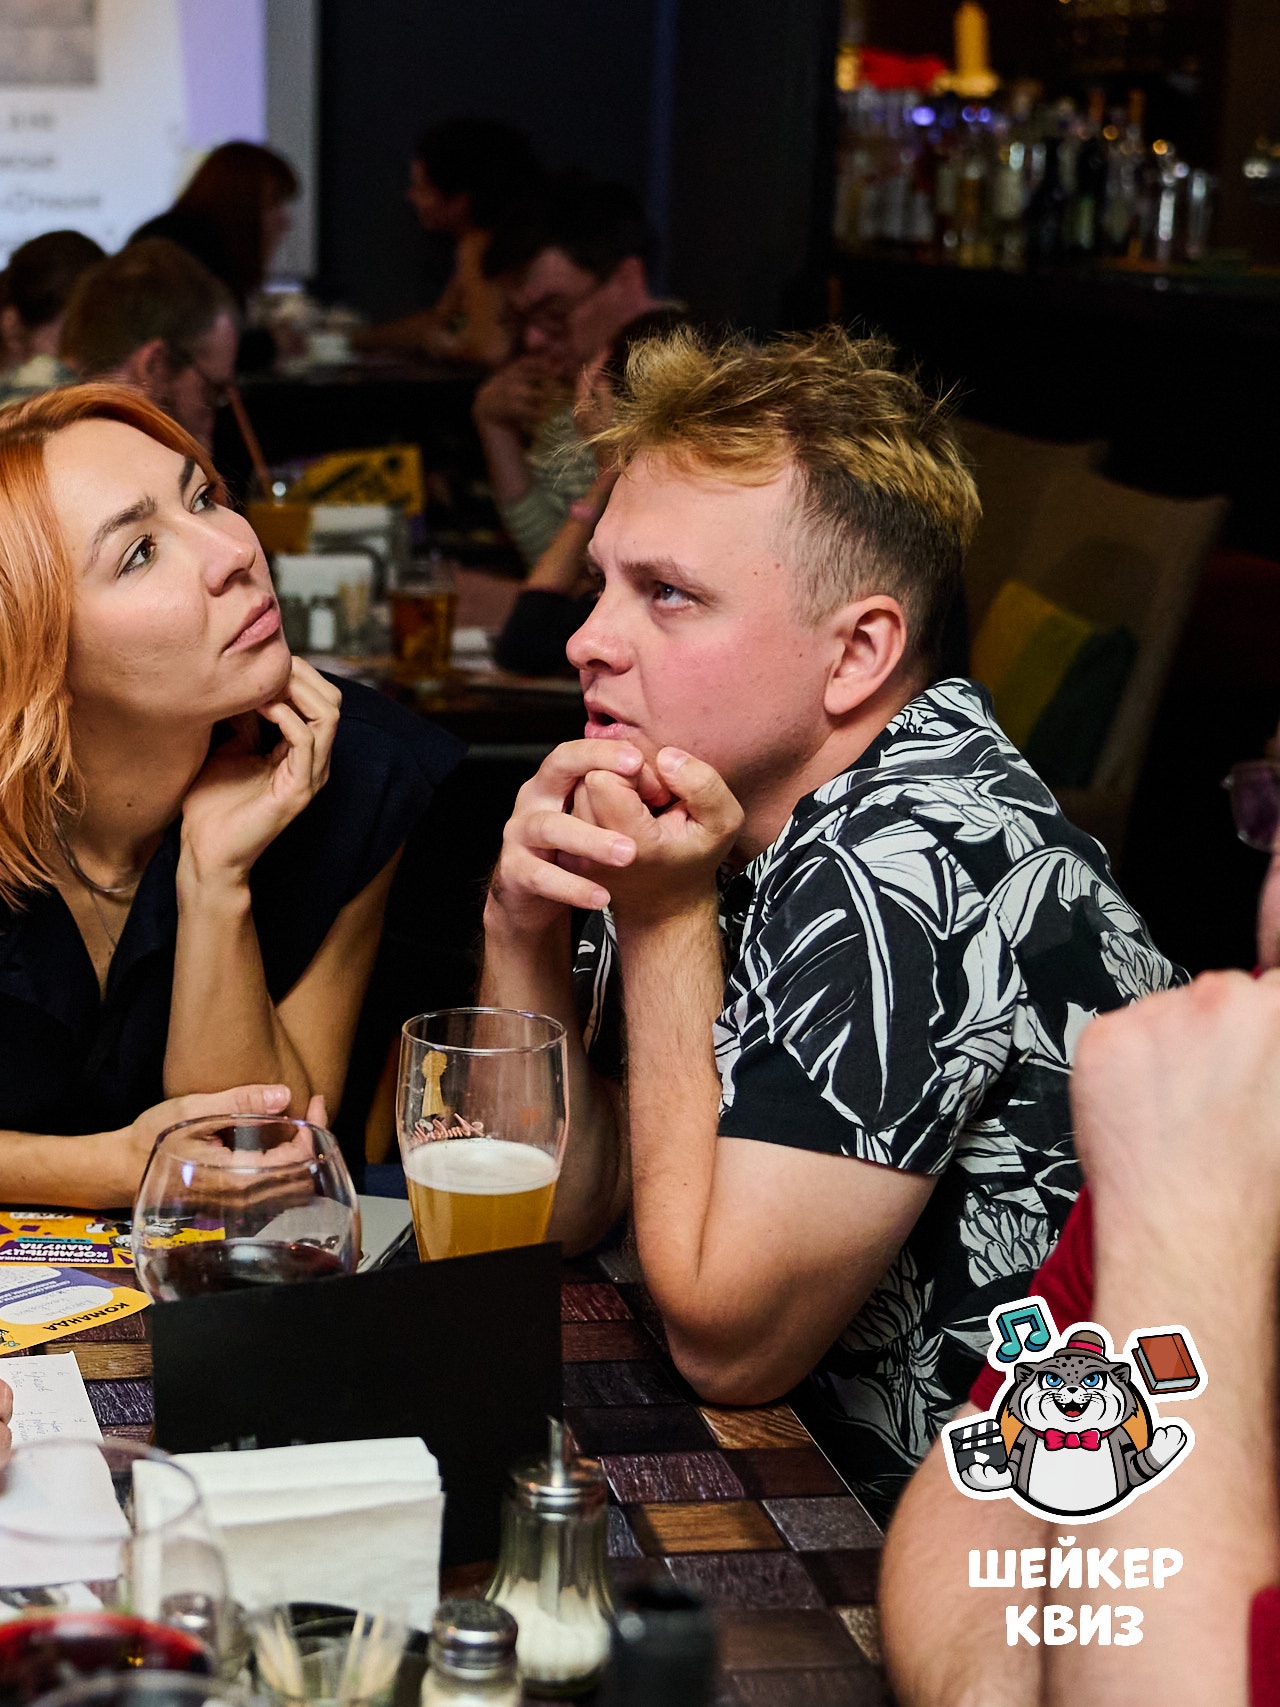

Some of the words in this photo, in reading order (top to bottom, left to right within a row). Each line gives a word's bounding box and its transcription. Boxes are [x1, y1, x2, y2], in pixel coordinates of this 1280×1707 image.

[19, 1243, 93, 1251] МАНУЛА
[0, 1248, 109, 1258] КОРМИЛЬЦУ
[41, 1302, 130, 1332] КОМАНДА
